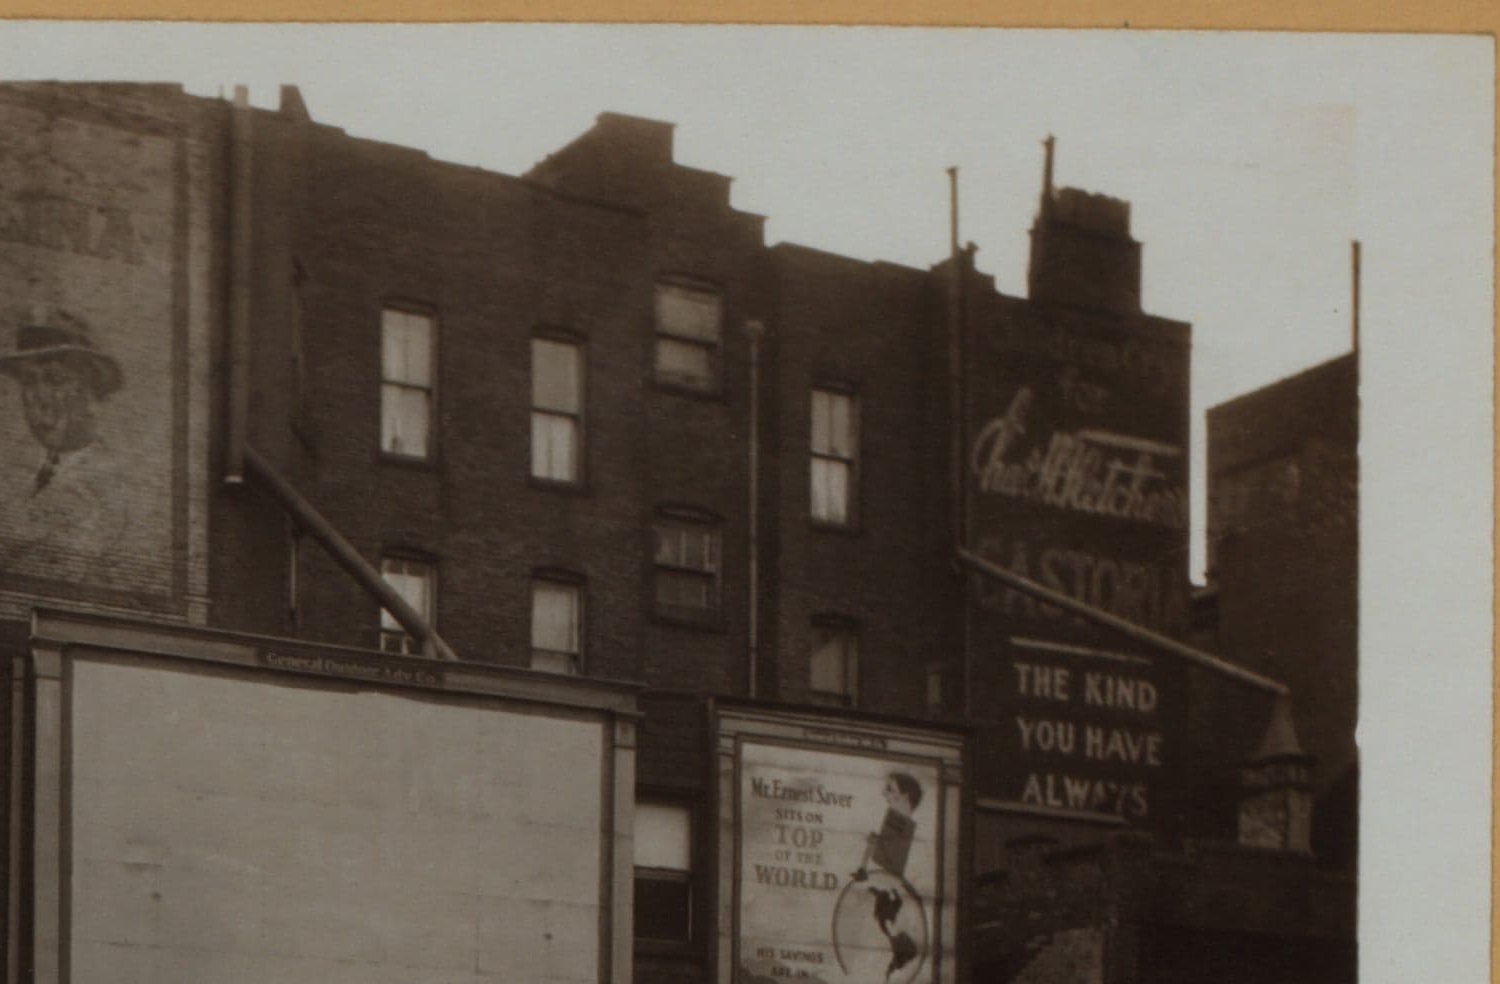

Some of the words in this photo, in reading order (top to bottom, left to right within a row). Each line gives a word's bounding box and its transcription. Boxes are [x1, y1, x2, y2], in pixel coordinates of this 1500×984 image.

[1013, 663, 1070, 701] THE
[1084, 671, 1158, 713] KIND
[1016, 716, 1076, 755] YOU
[1085, 725, 1164, 769] HAVE
[1021, 772, 1148, 818] ALWAYS
[774, 808, 803, 822] SITS
[805, 812, 823, 824] ON
[774, 823, 824, 848] TOP
[774, 850, 791, 861] OF
[797, 852, 823, 866] THE
[754, 863, 838, 890] WORLD
